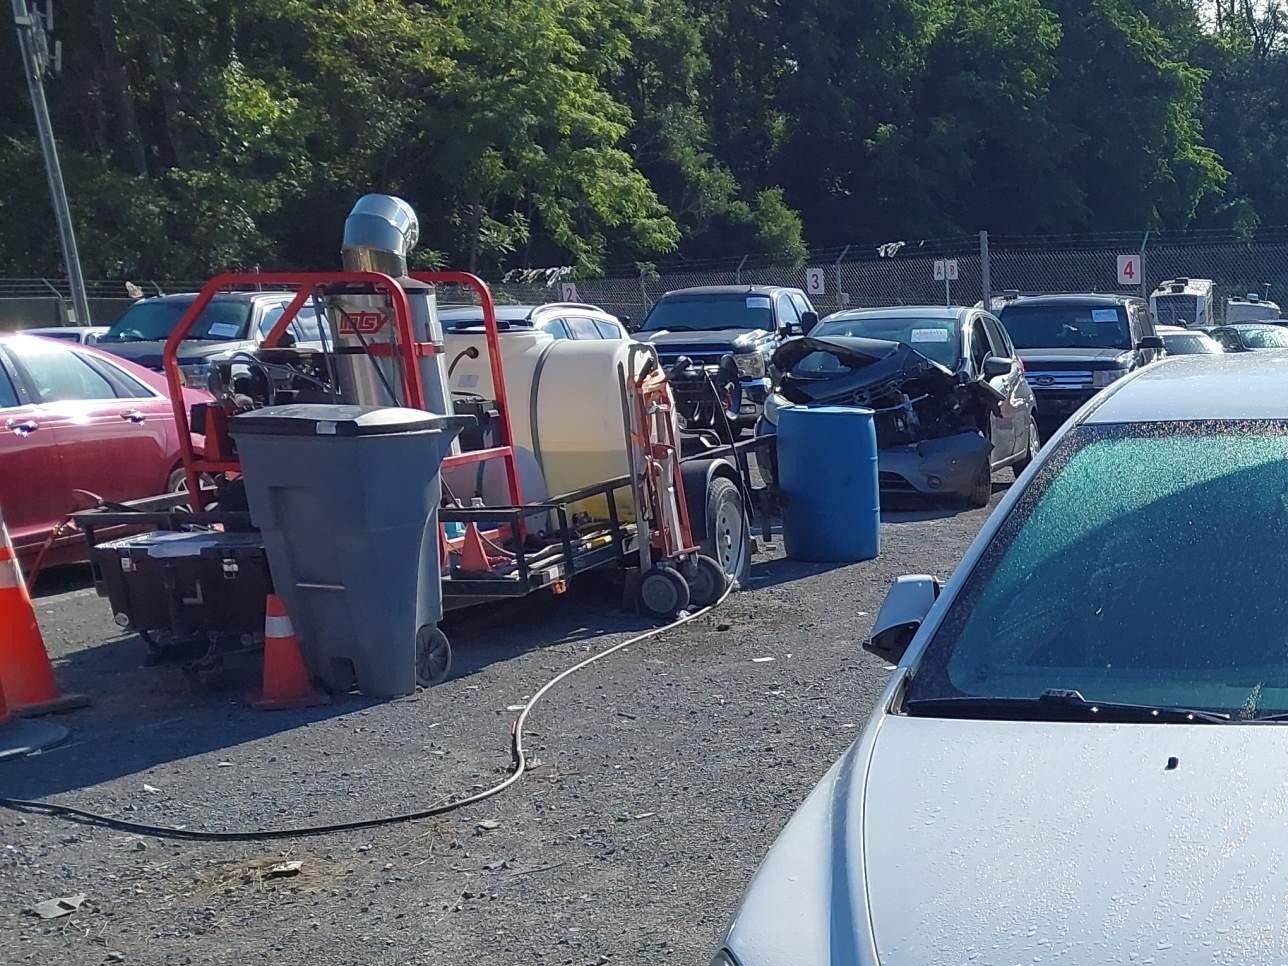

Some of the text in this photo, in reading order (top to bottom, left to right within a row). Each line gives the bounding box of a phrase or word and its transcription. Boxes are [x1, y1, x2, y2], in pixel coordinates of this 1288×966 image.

[1123, 260, 1135, 280] 4
[811, 273, 820, 290] 3
[566, 287, 573, 302] 2
